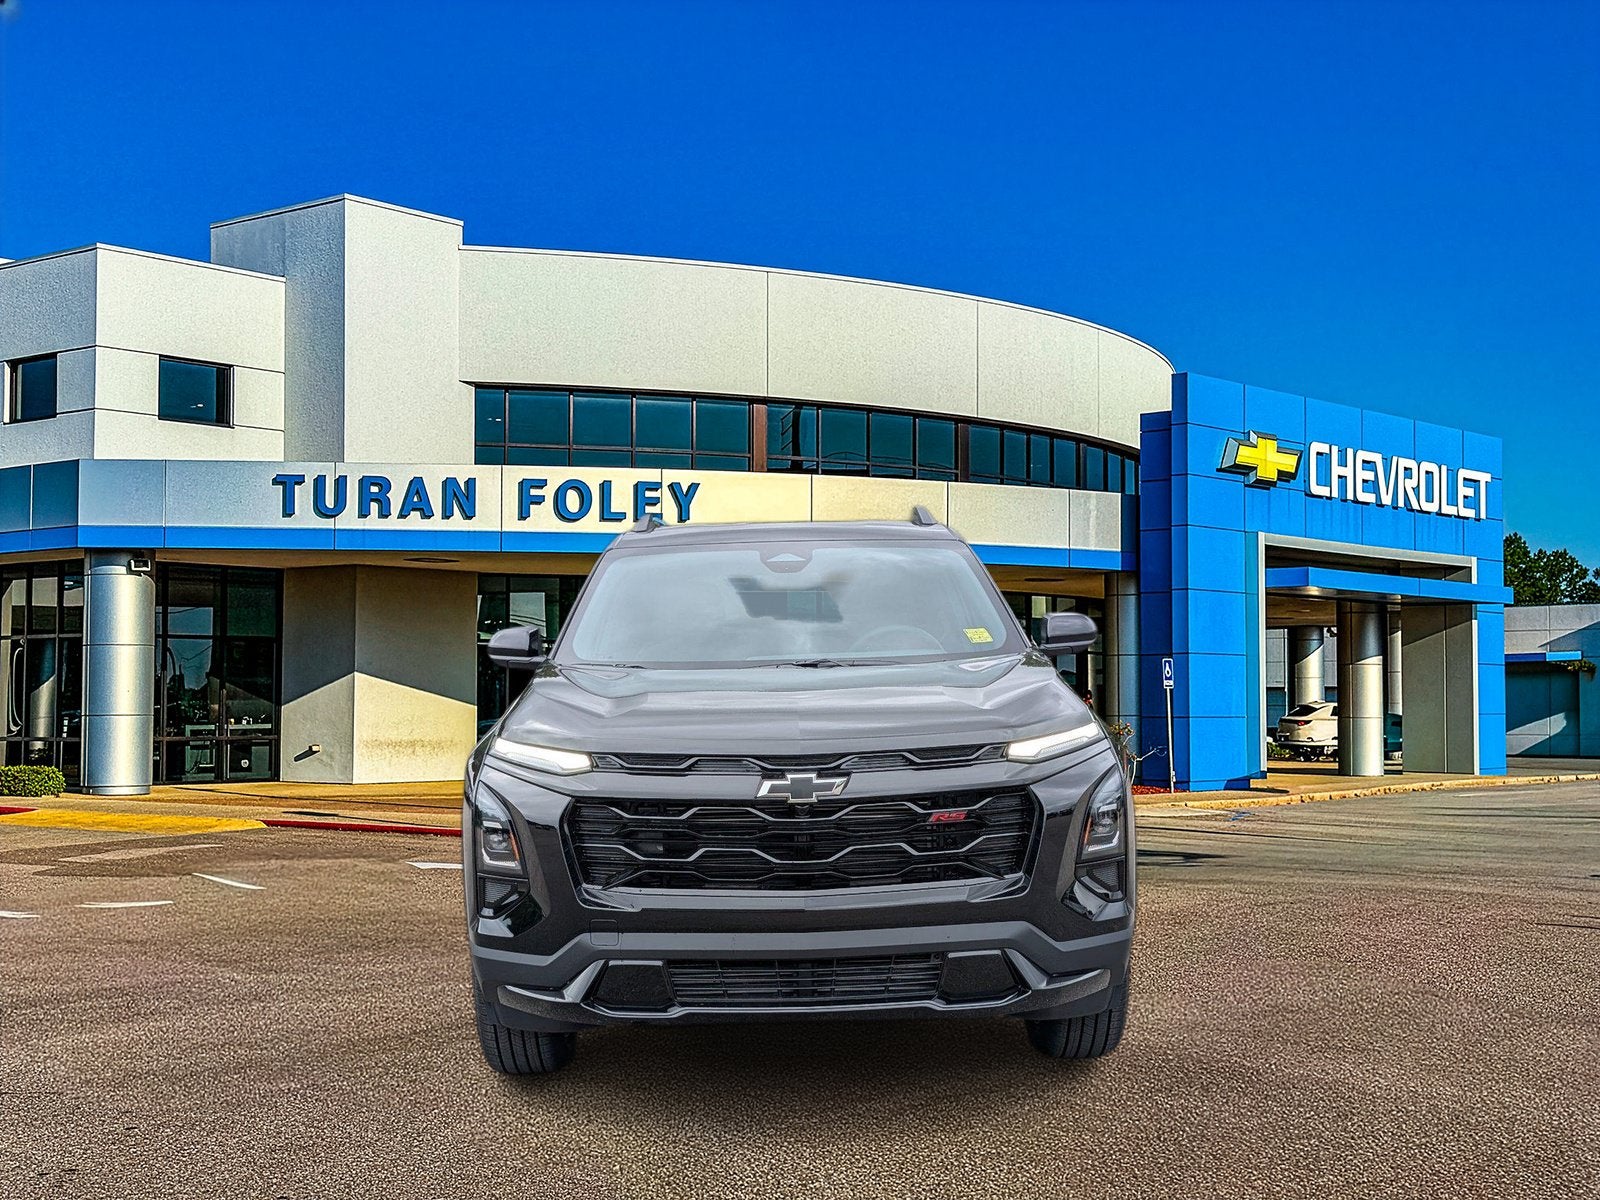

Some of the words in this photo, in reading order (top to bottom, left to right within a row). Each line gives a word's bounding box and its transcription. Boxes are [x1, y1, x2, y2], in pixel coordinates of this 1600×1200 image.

[272, 474, 476, 520] TURAN
[517, 478, 700, 523] FOLEY
[1308, 441, 1492, 520] CHEVROLET
[929, 811, 967, 824] RS
